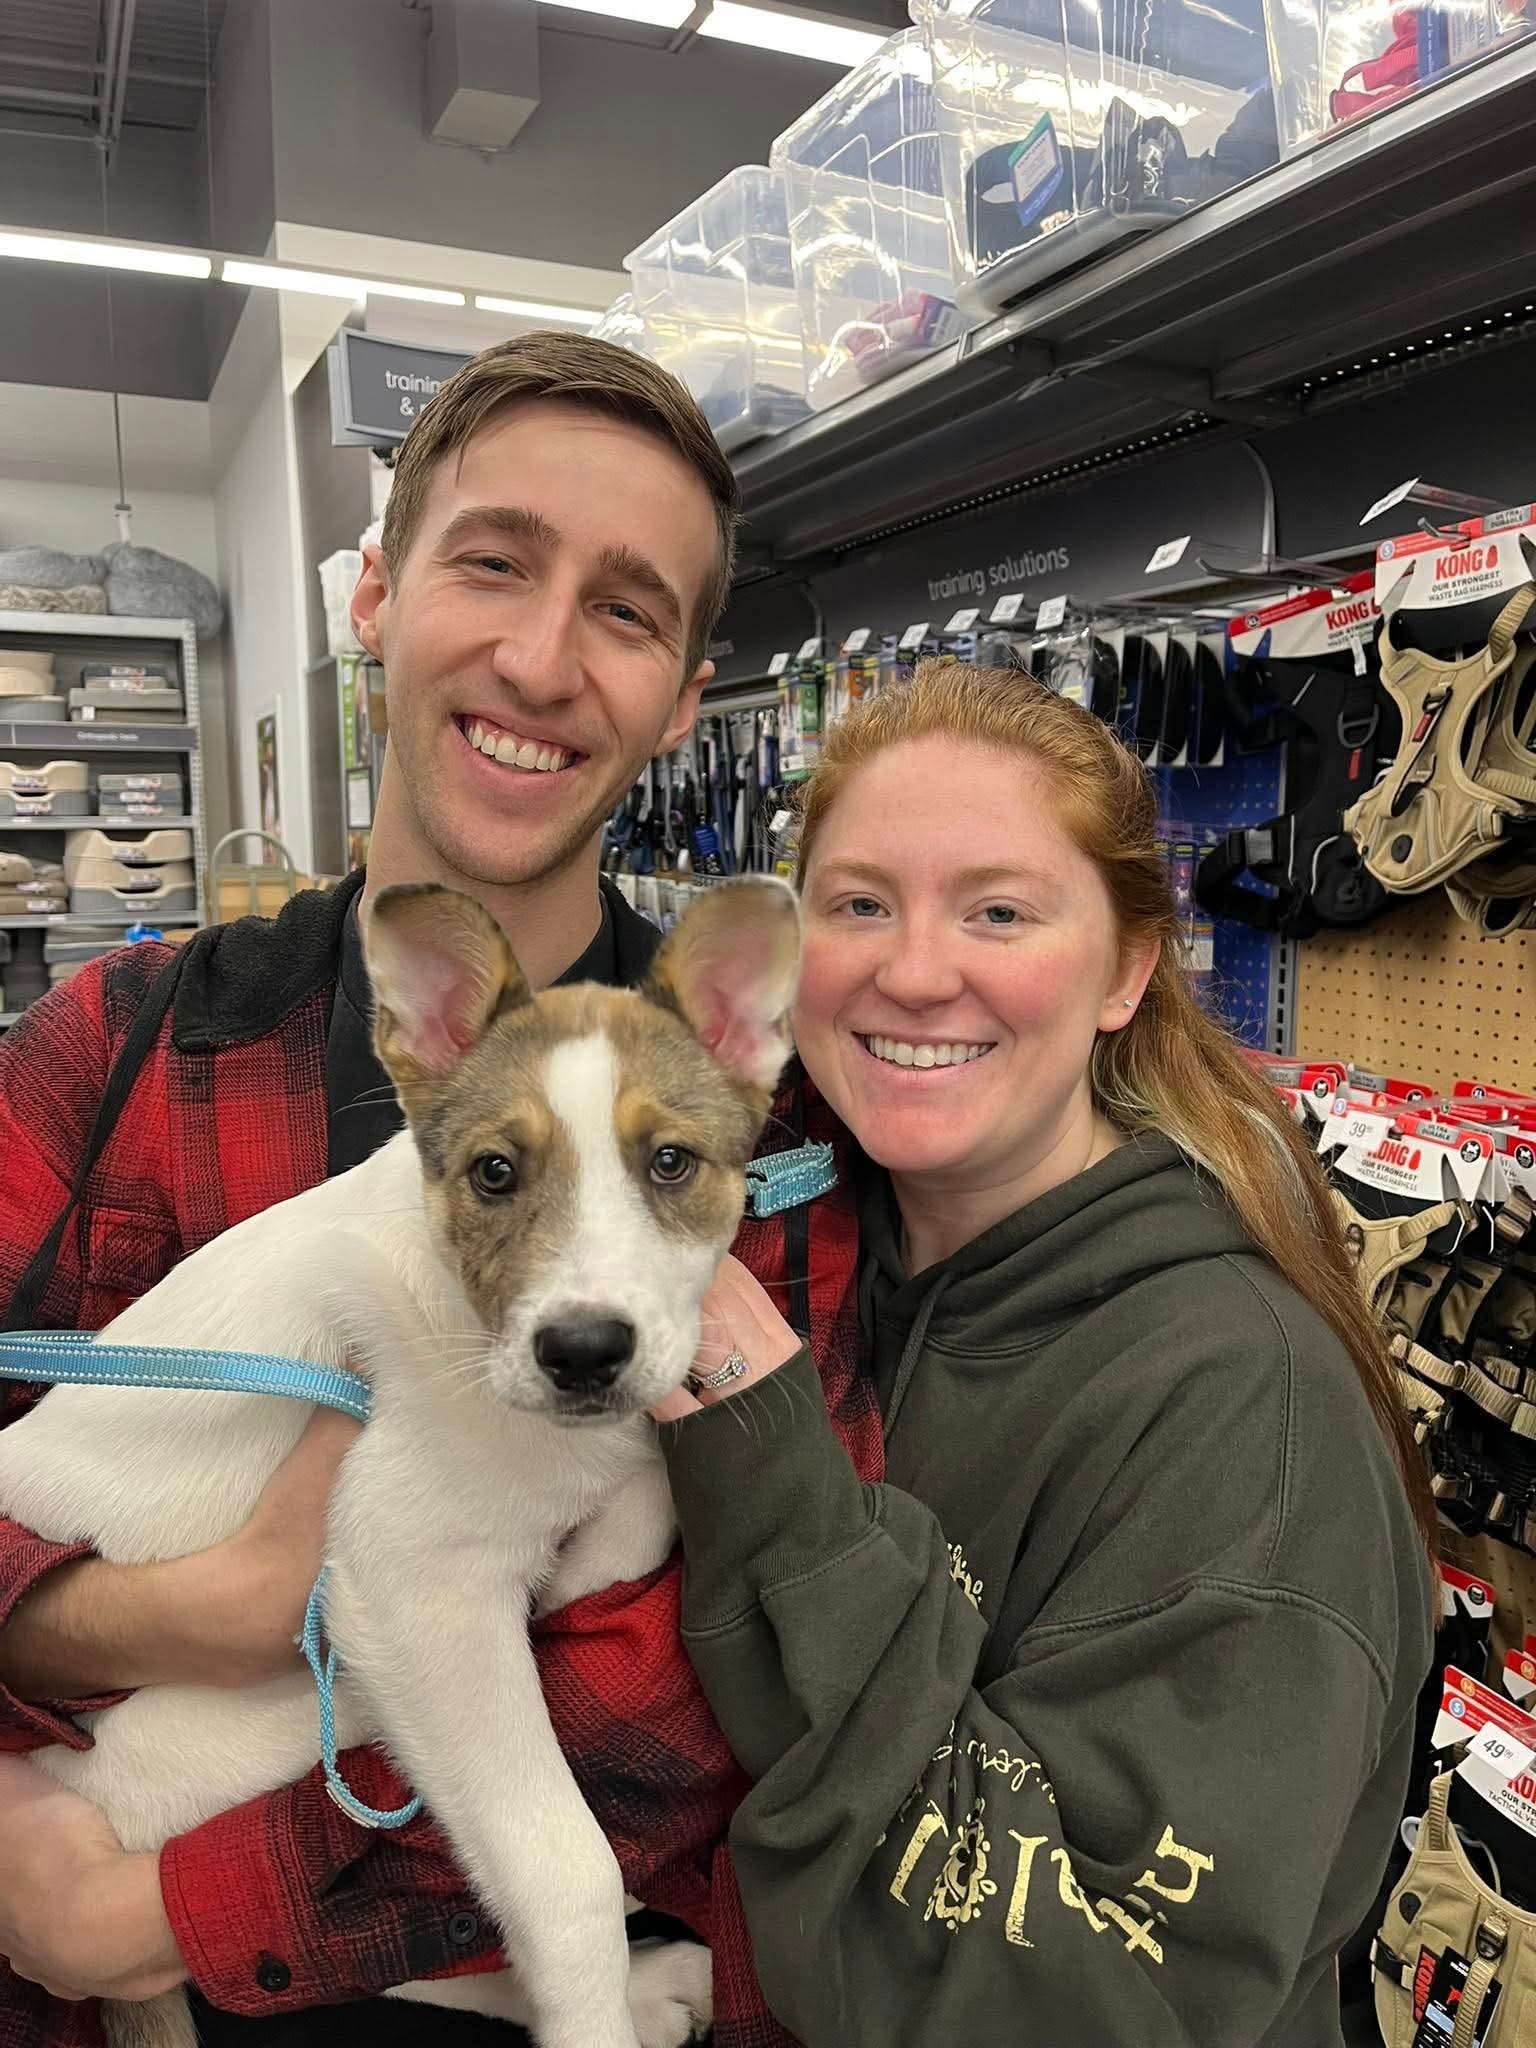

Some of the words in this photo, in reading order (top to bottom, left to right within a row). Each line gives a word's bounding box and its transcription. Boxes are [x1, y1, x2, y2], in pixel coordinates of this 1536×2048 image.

[385, 370, 441, 394] trainin
[399, 397, 414, 416] &
[928, 569, 987, 601] training
[989, 547, 1070, 586] solutions
[1436, 548, 1484, 581] KONG
[1431, 581, 1450, 593] OUR
[1326, 600, 1370, 631] KONG
[1483, 1738, 1506, 1759] 49
[1488, 1790, 1524, 1821] TACTICAL
[1501, 1789, 1519, 1807] OUR
